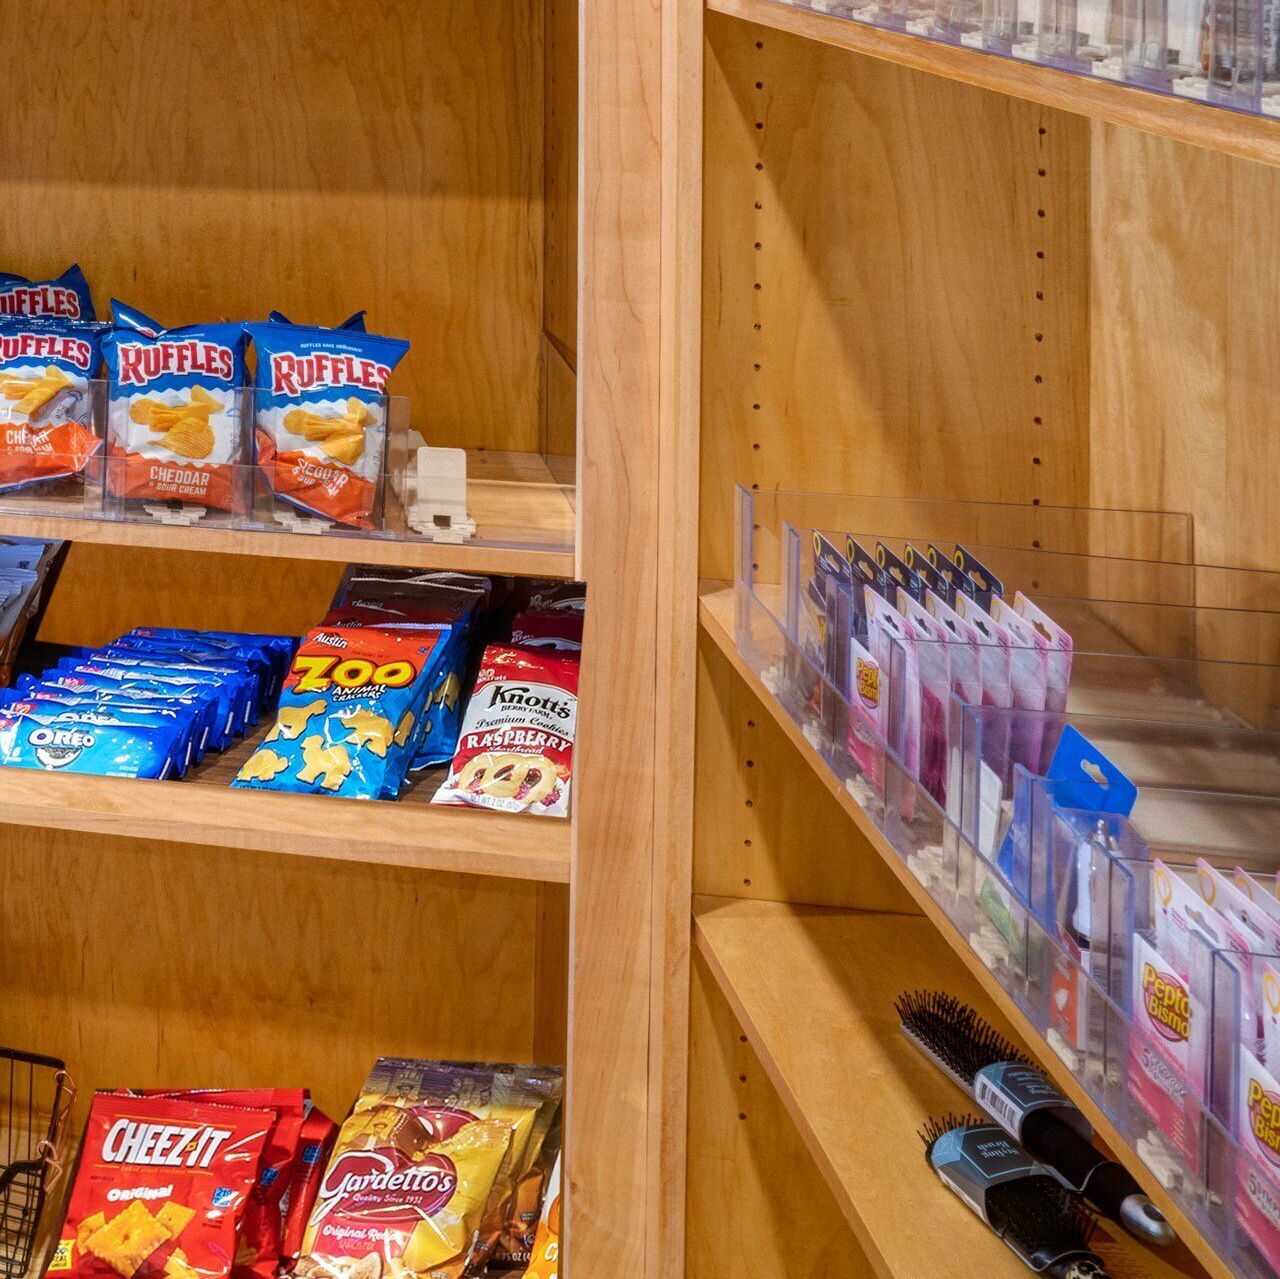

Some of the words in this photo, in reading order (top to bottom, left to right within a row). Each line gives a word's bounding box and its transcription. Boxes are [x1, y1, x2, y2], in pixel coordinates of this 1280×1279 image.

[119, 340, 234, 386] RUFFLES
[271, 352, 391, 397] RUFFLES
[150, 466, 210, 486] CHEDDAR
[156, 483, 176, 492] SOUR
[179, 485, 207, 496] CREAM
[312, 632, 348, 649] Austin
[292, 655, 417, 694] ZOO
[332, 684, 388, 696] ANIMAL
[333, 692, 382, 702] CRACKERS
[487, 685, 571, 719] Knott's
[501, 704, 527, 714] BERRY
[475, 716, 526, 729] Premium
[529, 716, 569, 737] Cookies
[28, 728, 95, 748] OREO
[467, 730, 572, 752] RASPBERRY
[486, 745, 544, 755] Shortbread
[976, 1140, 1010, 1152] Brush
[980, 1147, 1020, 1159] Styling
[309, 1152, 453, 1226] Gardetto's
[352, 1194, 382, 1203] Quality
[383, 1194, 403, 1203] Since
[323, 1224, 366, 1240] Original
